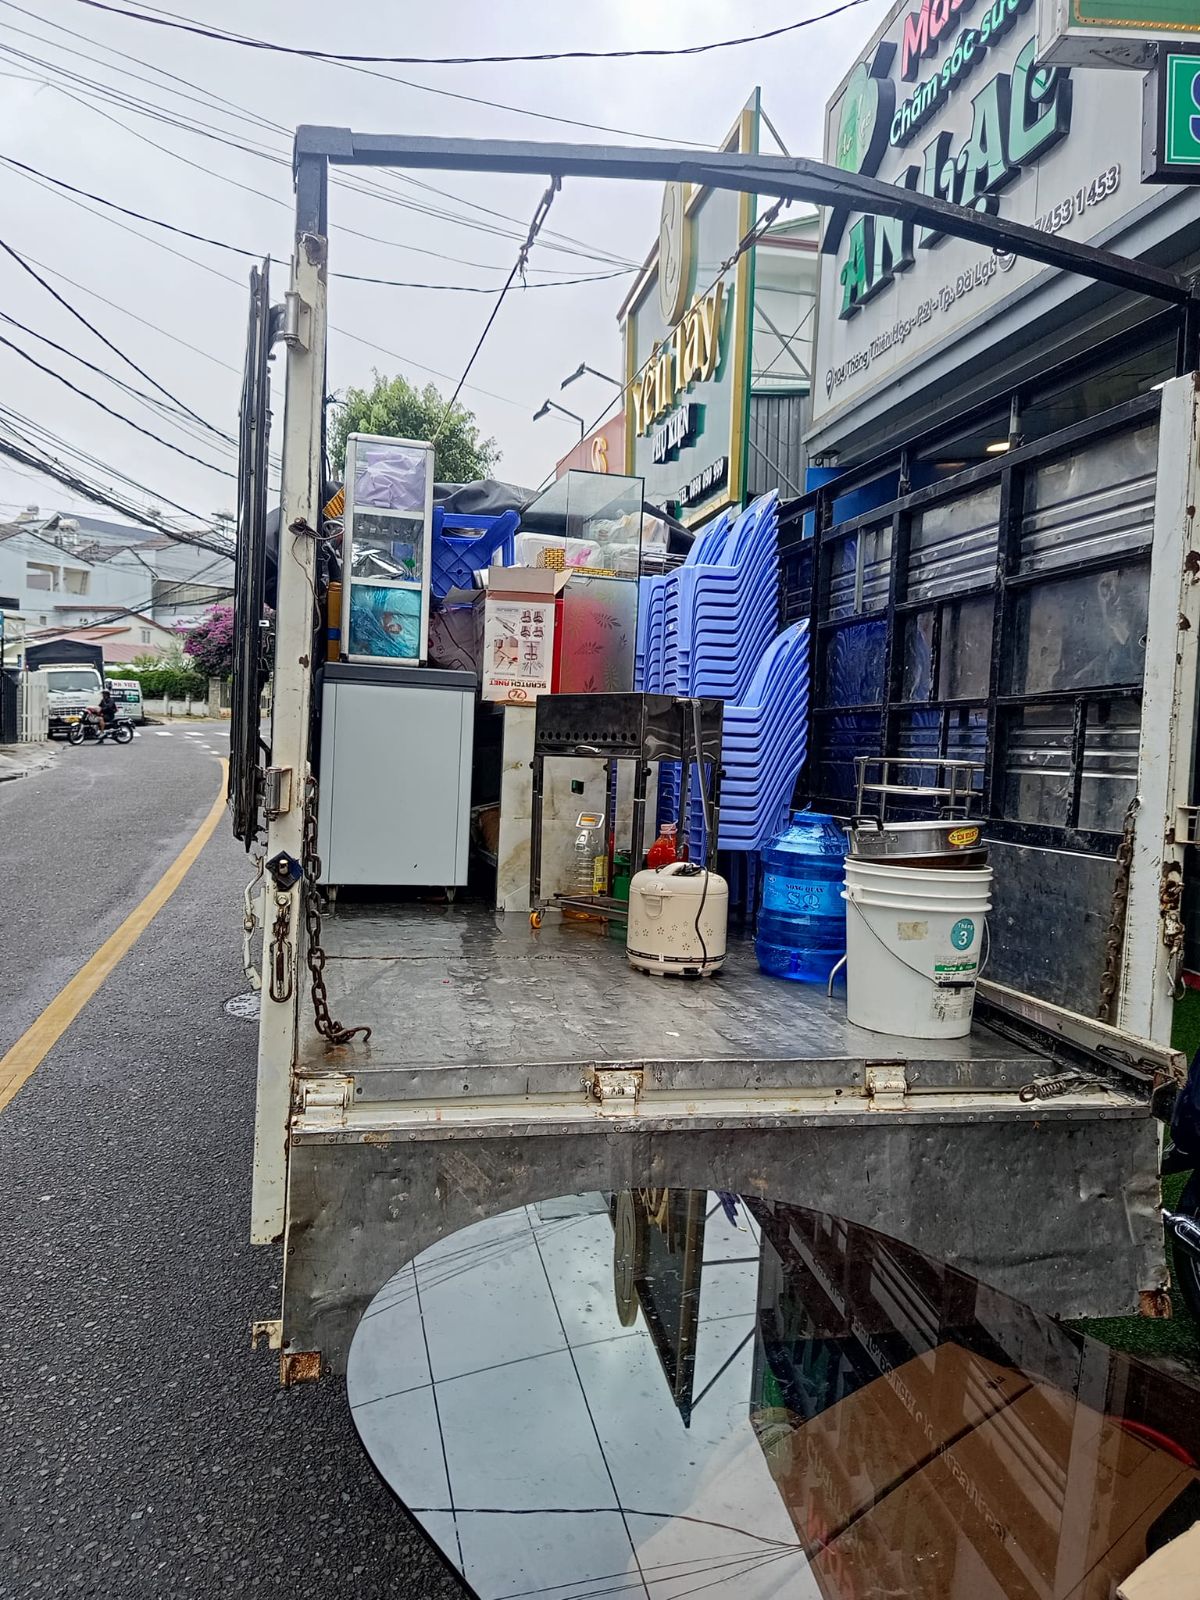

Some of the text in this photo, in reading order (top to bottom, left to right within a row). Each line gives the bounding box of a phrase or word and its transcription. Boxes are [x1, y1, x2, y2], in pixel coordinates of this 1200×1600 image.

[889, 74, 938, 146] Chăm
[941, 30, 976, 90] sóc
[1044, 199, 1073, 233] 453
[1076, 188, 1085, 214] 1
[1087, 164, 1119, 206] 453
[958, 930, 967, 945] 3
